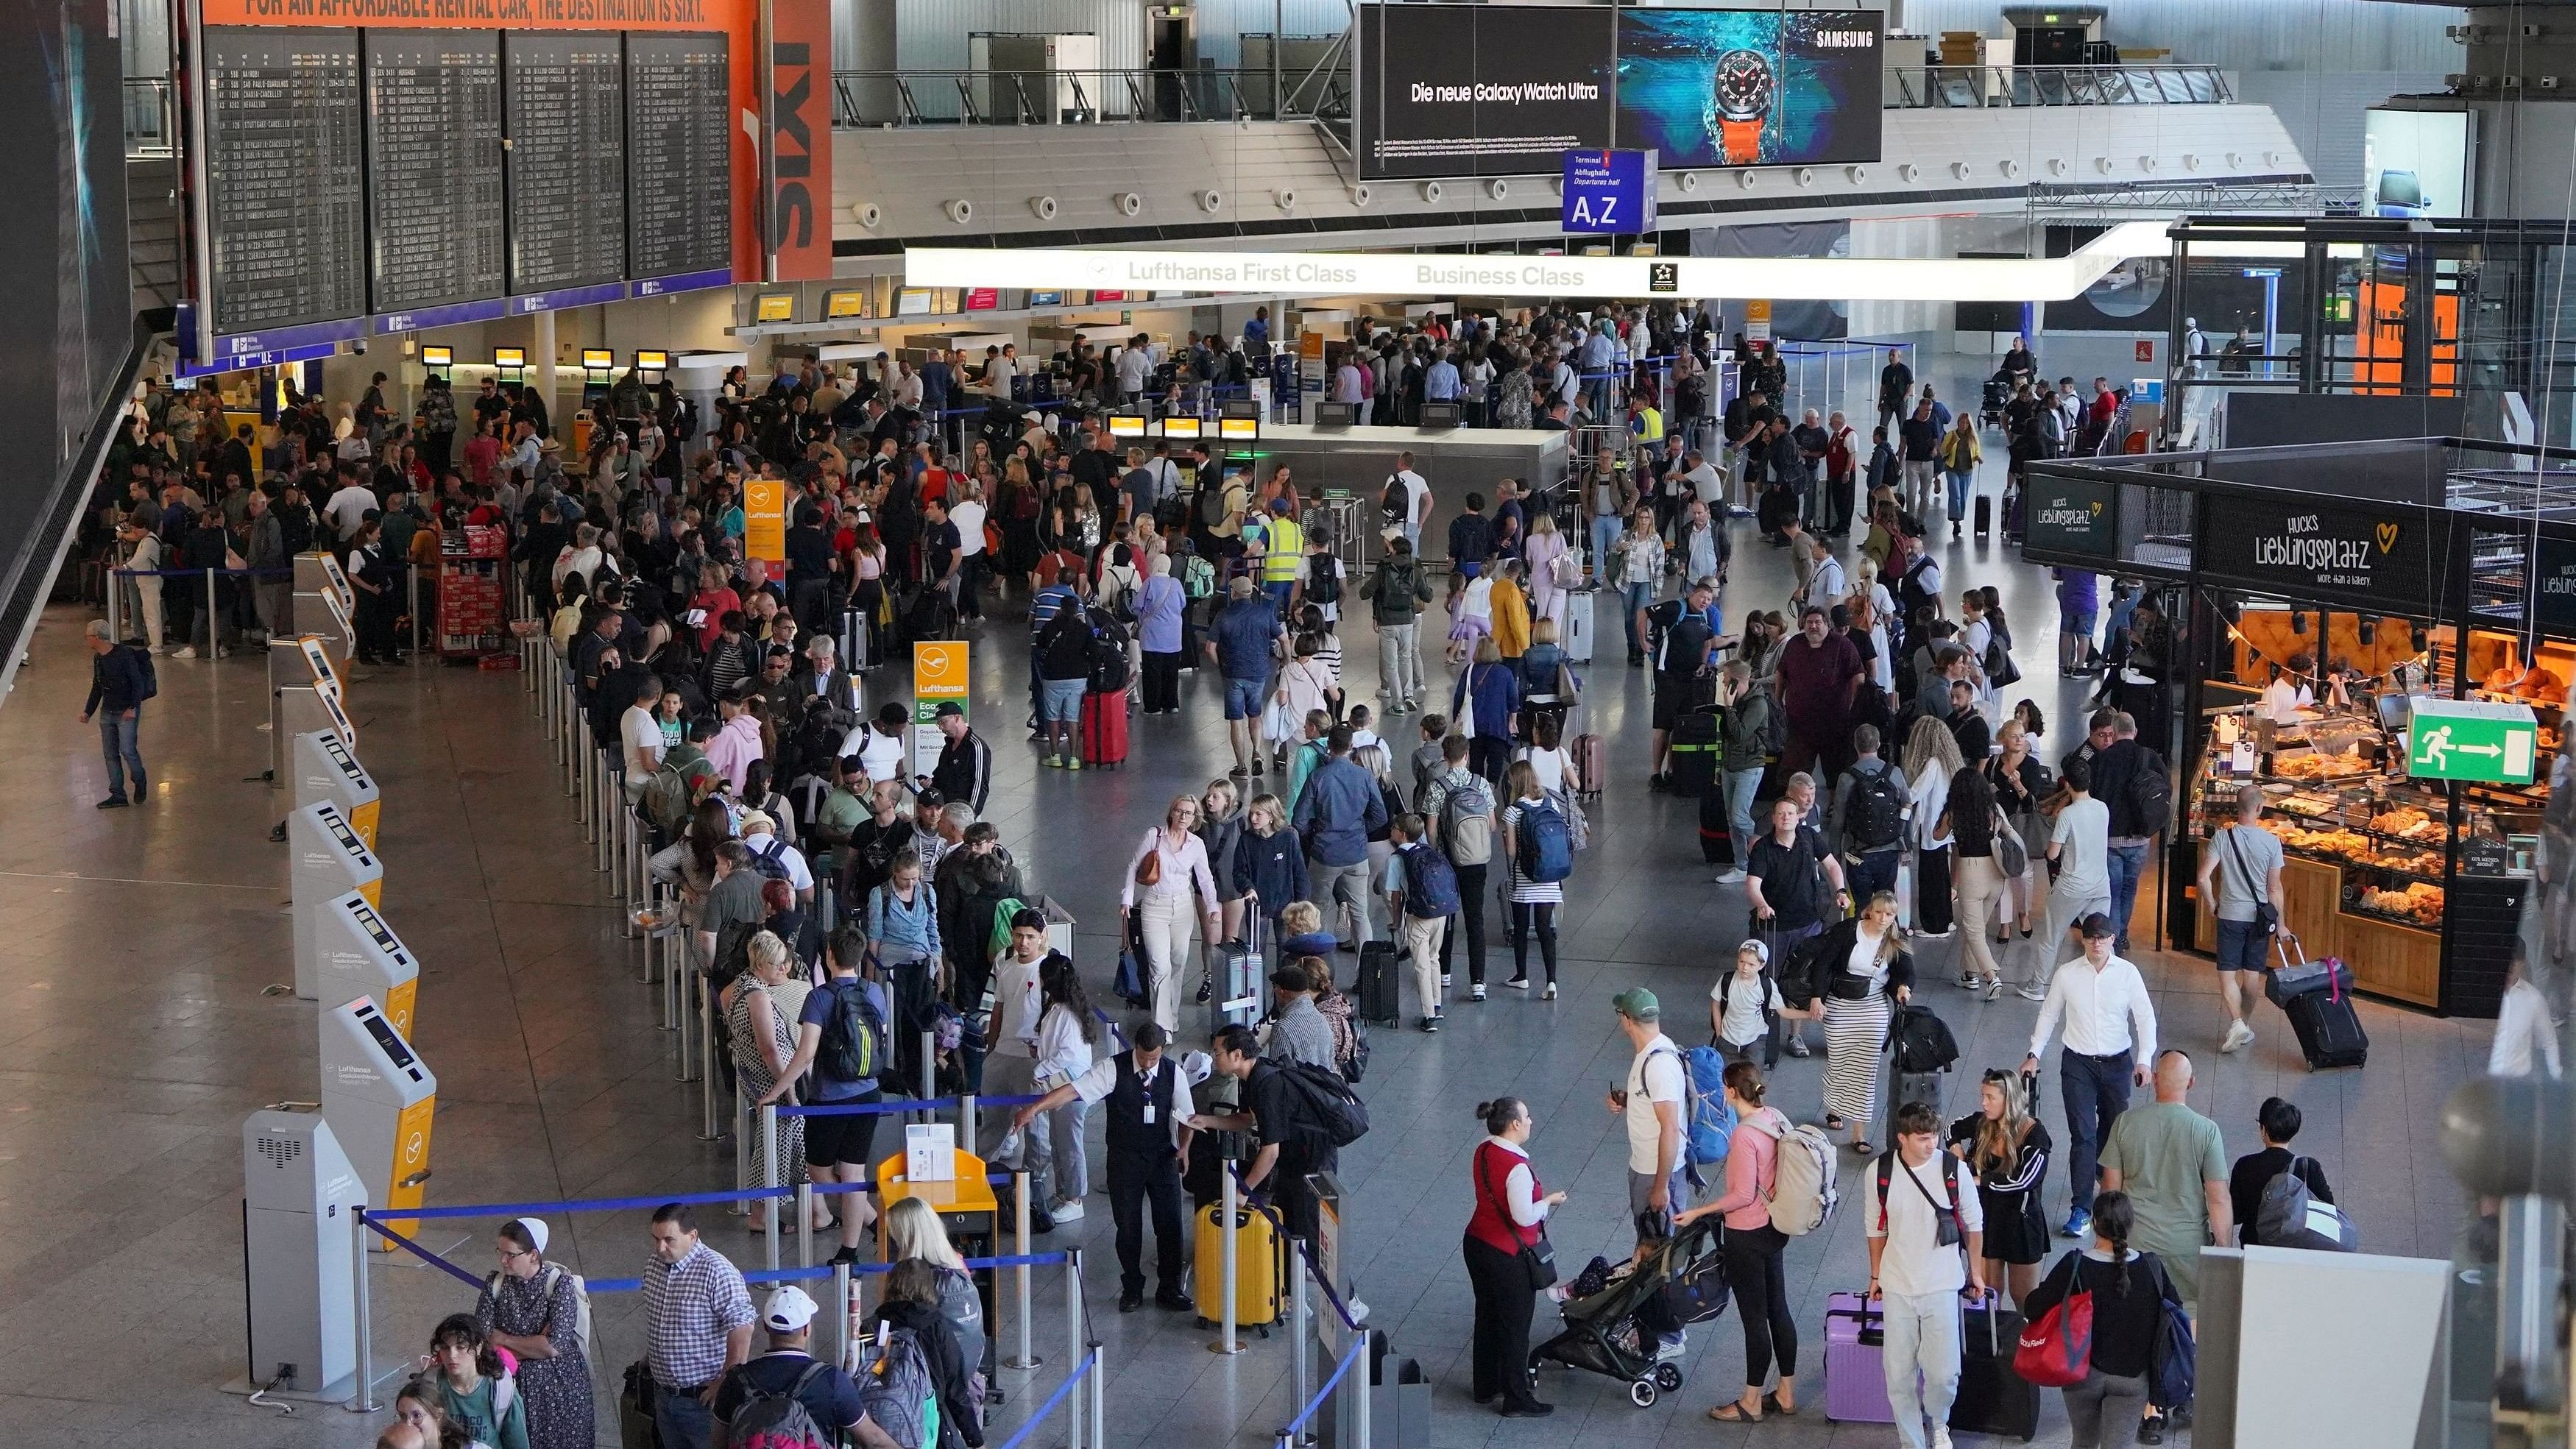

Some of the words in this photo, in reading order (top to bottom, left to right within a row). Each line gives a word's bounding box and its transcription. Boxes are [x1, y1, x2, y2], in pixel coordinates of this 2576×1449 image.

[289, 0, 313, 15] AN
[319, 0, 429, 18] AFFORDABLE
[435, 0, 493, 19] RENTAL
[498, 0, 533, 25] CAR,
[538, 0, 563, 20] THE
[568, 0, 655, 21] DESTINATION
[659, 0, 671, 22] IS
[675, 0, 704, 22] SIXT.
[1817, 31, 1873, 47] SAMSUNG
[1412, 81, 1433, 102] Die
[1436, 86, 1471, 102] neue
[1474, 82, 1524, 105] Galaxy
[1524, 83, 1566, 100] Watch
[1568, 83, 1598, 100] Ultra
[1572, 196, 1617, 227] A,Z
[1129, 261, 1236, 281] Lufthansa
[1243, 262, 1290, 282] First
[1296, 262, 1357, 283] Class
[1417, 265, 1516, 285] Business
[1522, 266, 1584, 287] Class
[2053, 498, 2067, 508] HUCKS
[2288, 515, 2319, 534] HUCKS
[2317, 574, 2331, 584] More
[2333, 574, 2345, 584] than
[2347, 576, 2351, 584] a
[2352, 575, 2371, 587] bakery.
[919, 684, 964, 692] Lufthansa
